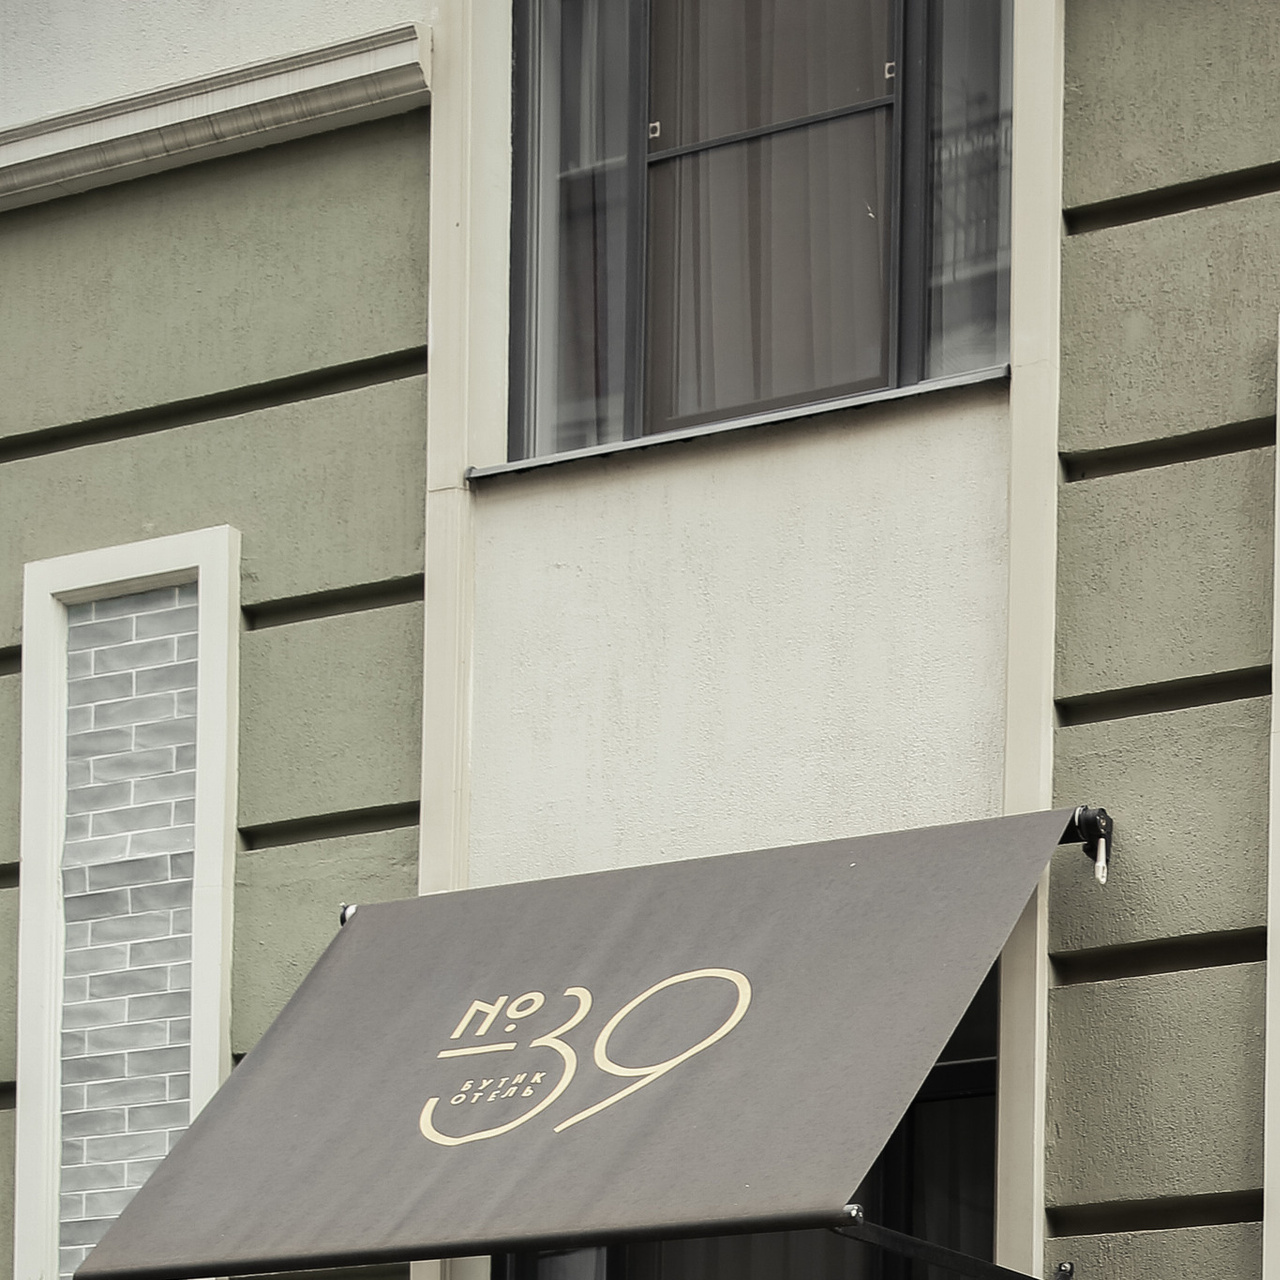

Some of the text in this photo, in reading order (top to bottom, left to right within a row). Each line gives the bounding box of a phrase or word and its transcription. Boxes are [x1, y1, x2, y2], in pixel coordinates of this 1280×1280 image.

[419, 968, 752, 1146] 39
[460, 1072, 547, 1092] БУТИК
[450, 1085, 534, 1105] ОТЕЛЬ
